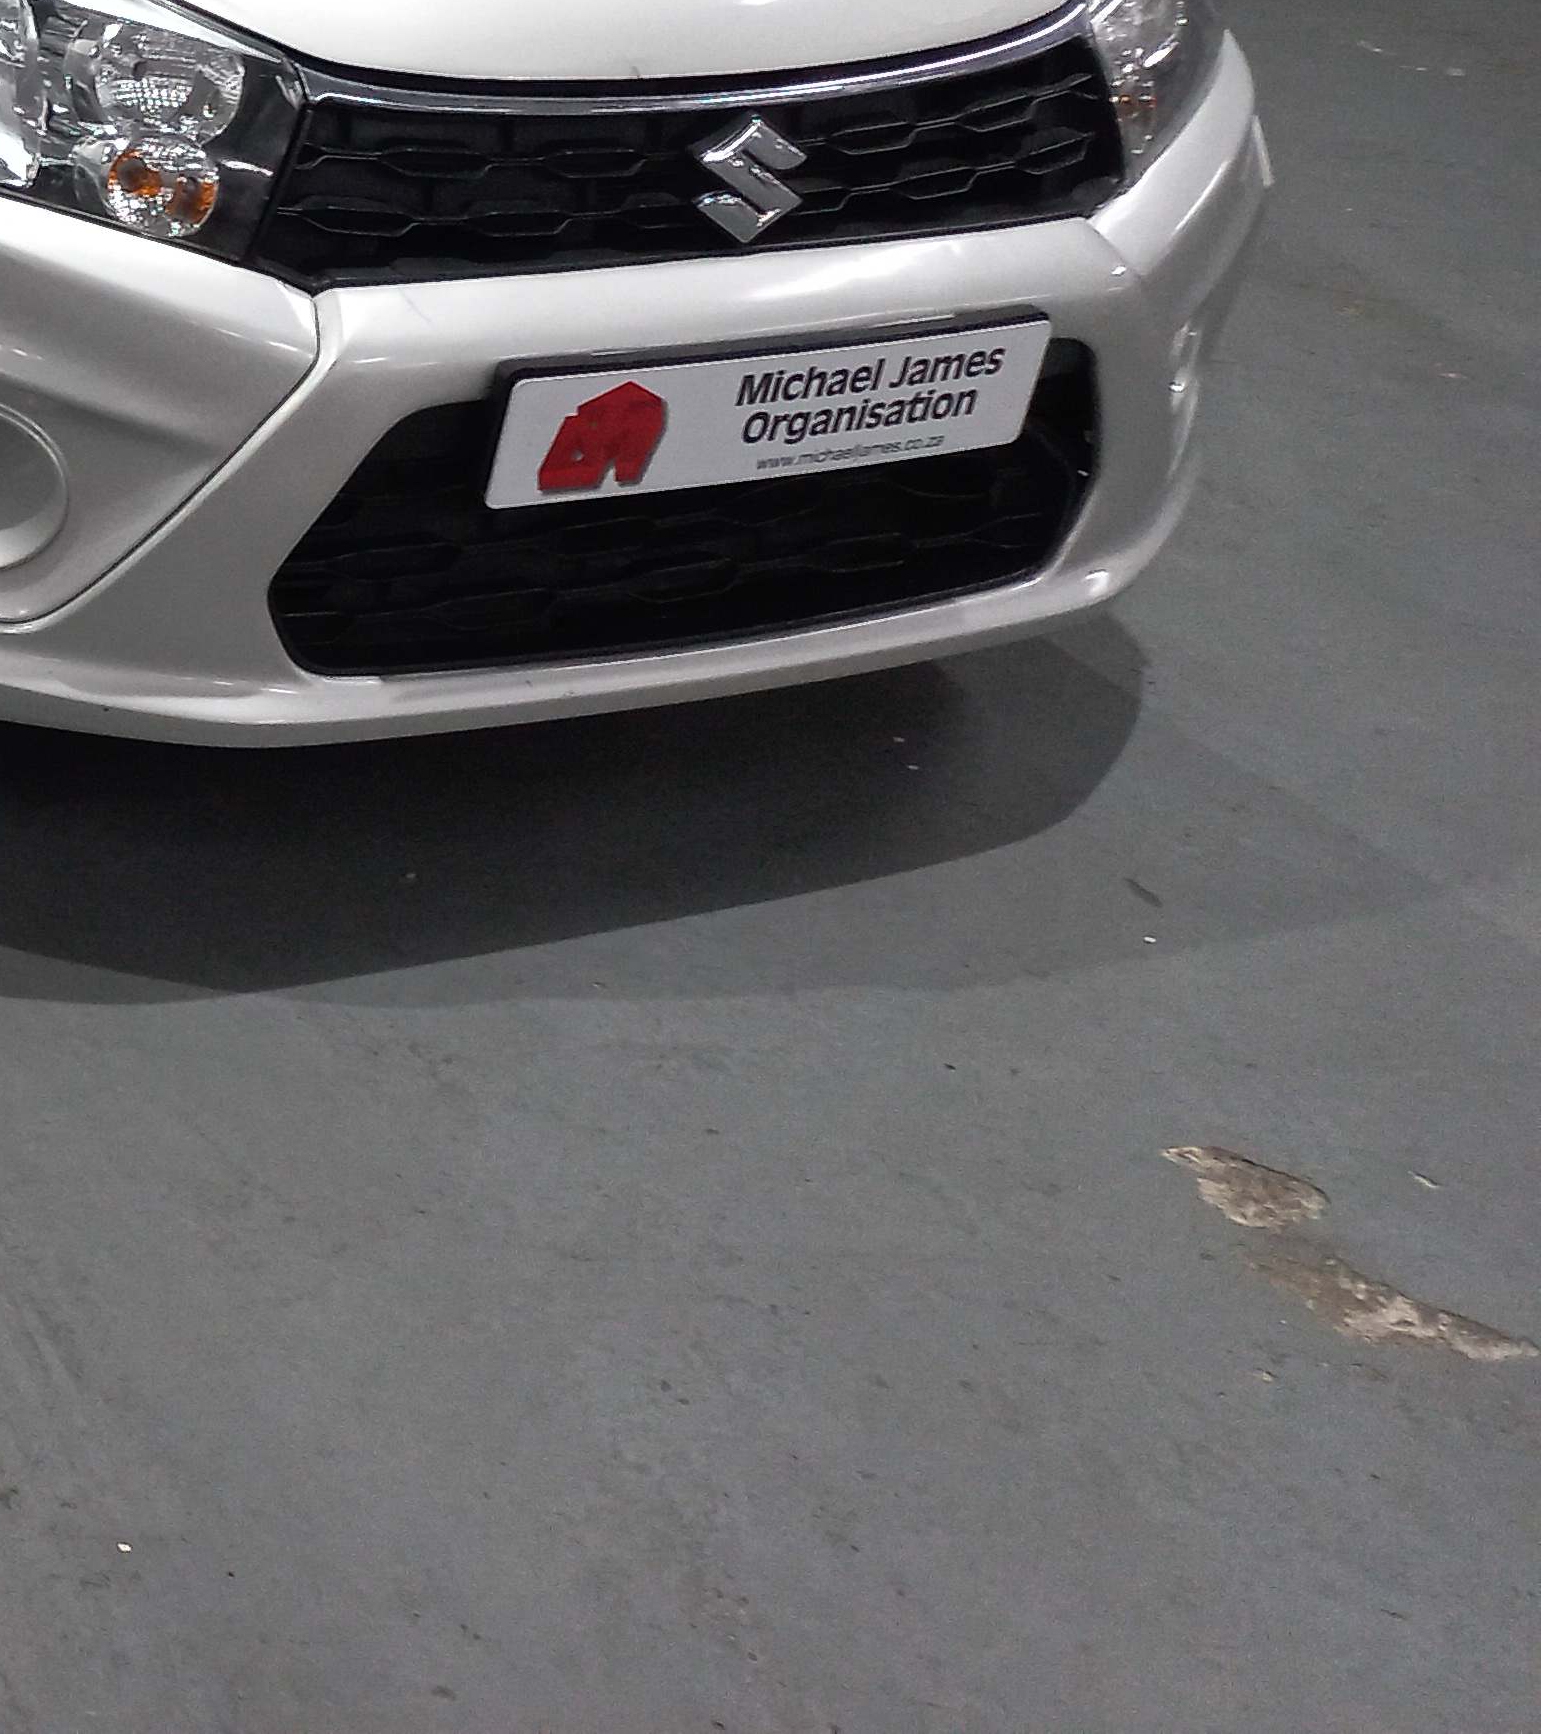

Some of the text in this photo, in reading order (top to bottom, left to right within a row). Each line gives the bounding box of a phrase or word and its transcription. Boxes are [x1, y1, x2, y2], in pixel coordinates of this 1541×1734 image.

[734, 347, 1007, 407] Michael James
[741, 388, 979, 445] Organisation
